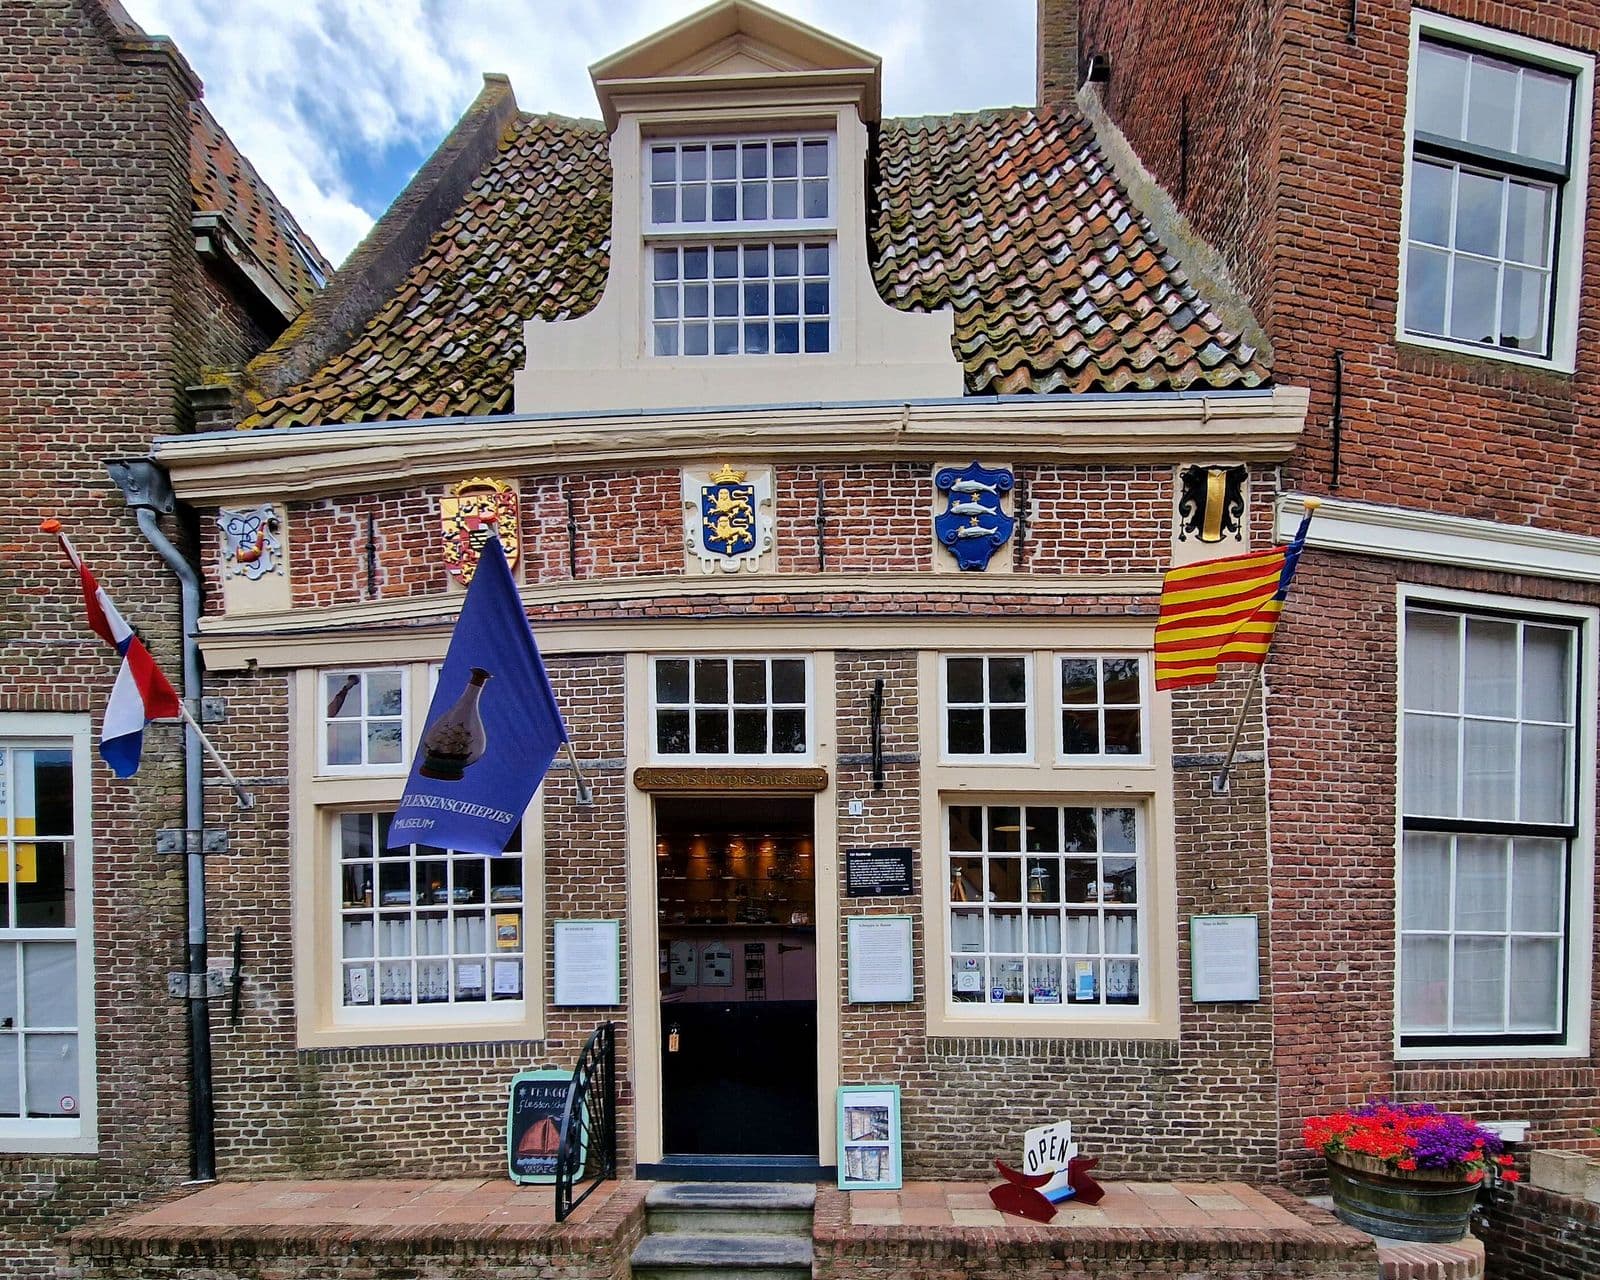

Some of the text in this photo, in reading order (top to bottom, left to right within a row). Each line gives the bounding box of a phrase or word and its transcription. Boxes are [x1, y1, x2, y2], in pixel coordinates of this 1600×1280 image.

[394, 818, 435, 829] MUSEUM
[401, 794, 514, 824] FLESSENSCHEEPJES
[1028, 1136, 1068, 1172] OPEN
